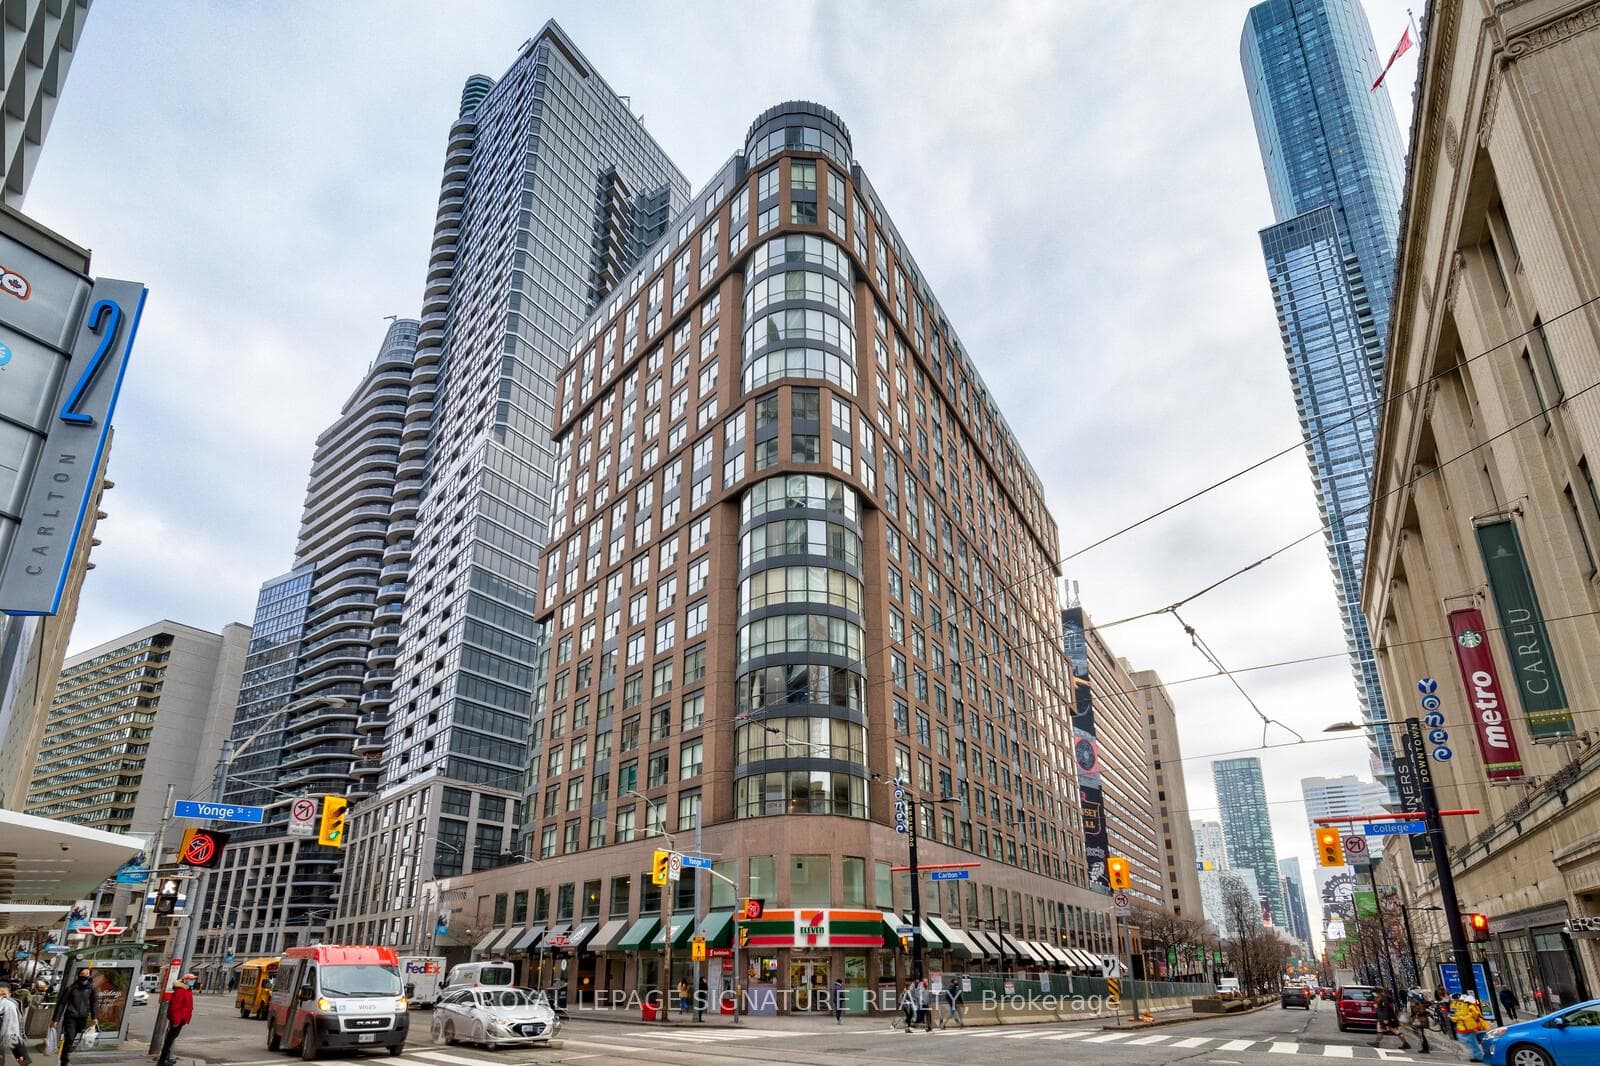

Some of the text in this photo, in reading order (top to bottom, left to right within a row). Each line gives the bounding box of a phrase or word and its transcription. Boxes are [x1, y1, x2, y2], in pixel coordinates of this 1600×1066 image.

[59, 299, 123, 424] 2
[25, 453, 77, 577] CARLTON
[1508, 607, 1549, 696] CARLU
[1417, 677, 1453, 762] Yonge
[1471, 670, 1510, 749] metro
[1409, 723, 1430, 783] DOWNTOWN
[197, 804, 235, 818] Yonge
[1372, 823, 1409, 834] College
[800, 911, 824, 945] 7
[405, 961, 441, 975] FedEx
